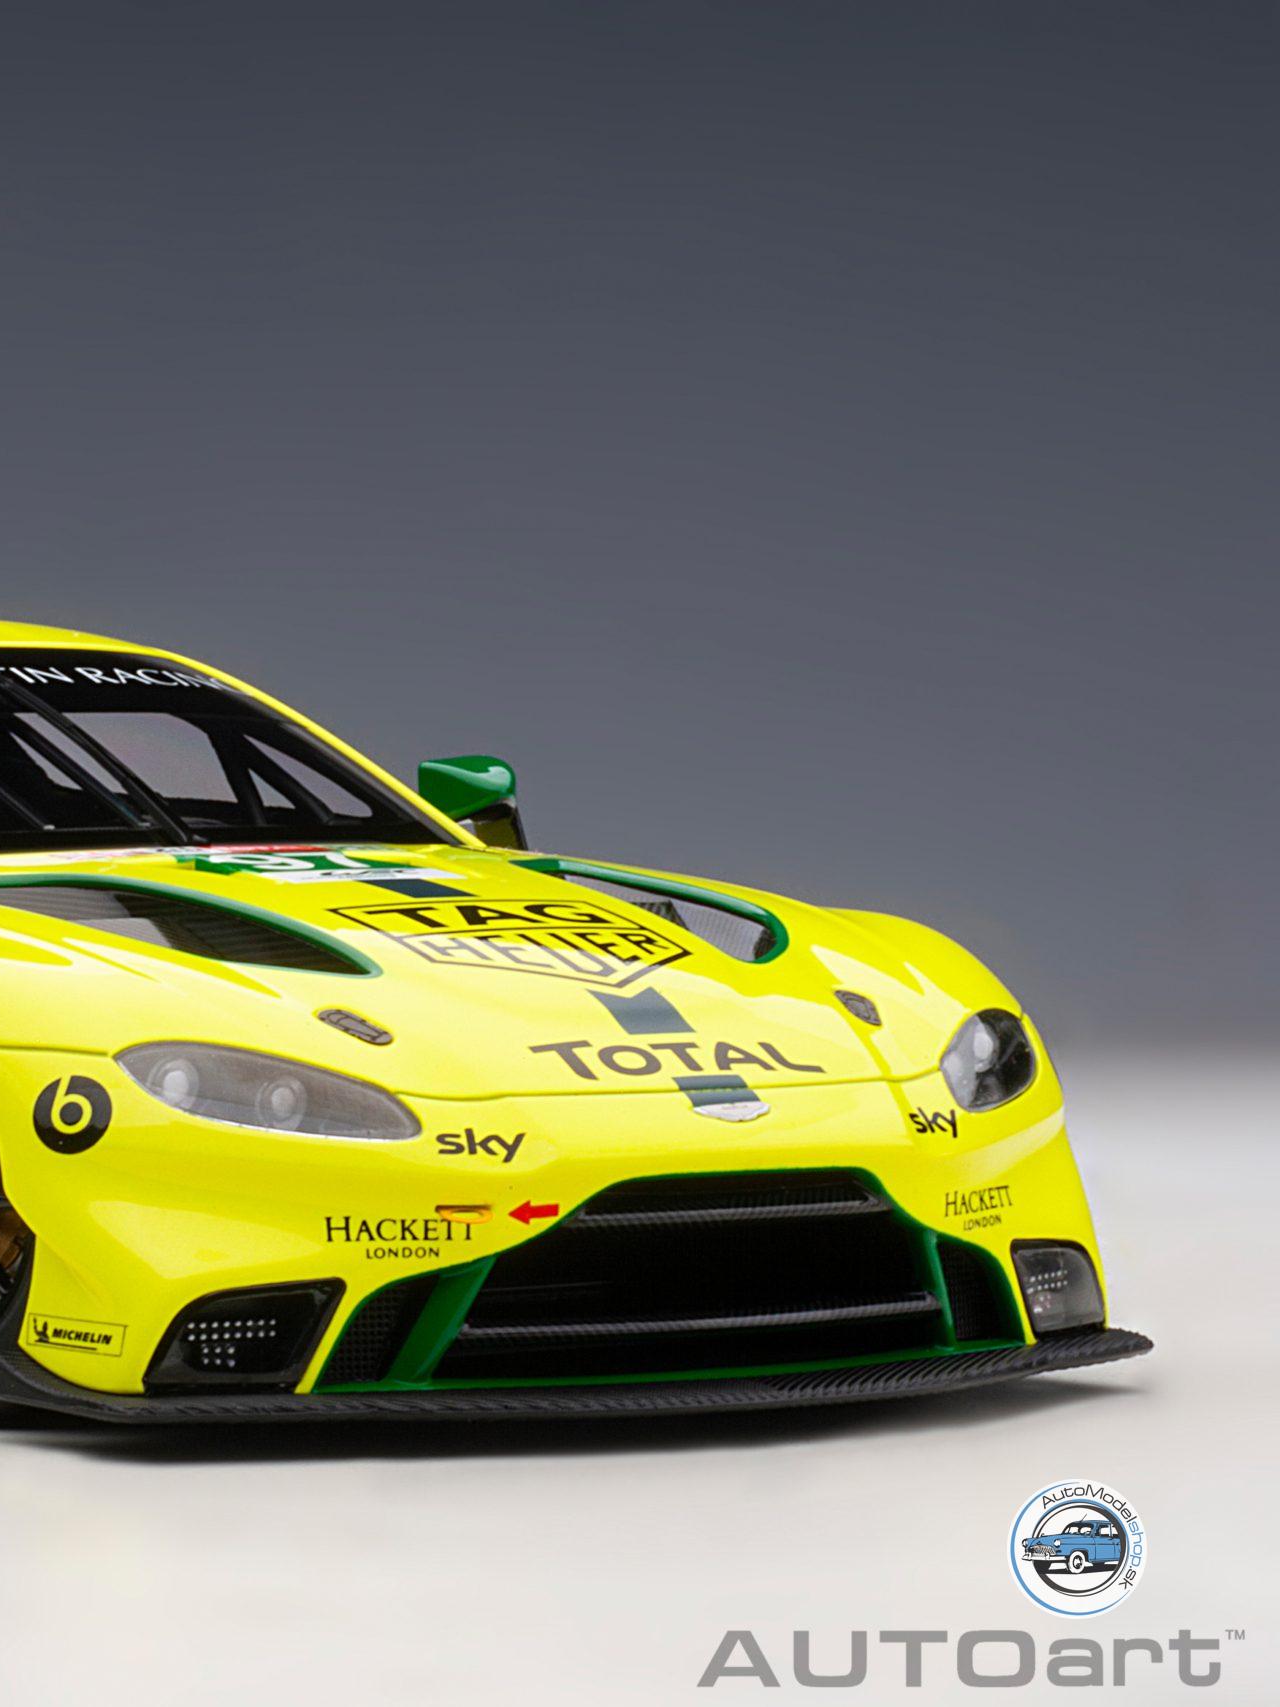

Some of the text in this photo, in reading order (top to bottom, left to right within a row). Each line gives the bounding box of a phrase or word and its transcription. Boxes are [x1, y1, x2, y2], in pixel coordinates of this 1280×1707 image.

[209, 851, 372, 871] 97
[366, 903, 622, 928] TAG
[421, 932, 674, 977] HEUER
[528, 1039, 827, 1081] TOTAL
[909, 1107, 958, 1138] sky
[435, 1128, 526, 1163] sky
[944, 1185, 1014, 1217] HACKETT
[963, 1214, 1003, 1231] LONDON
[366, 1247, 440, 1259] LONDON
[51, 1326, 113, 1346] MICHELIN
